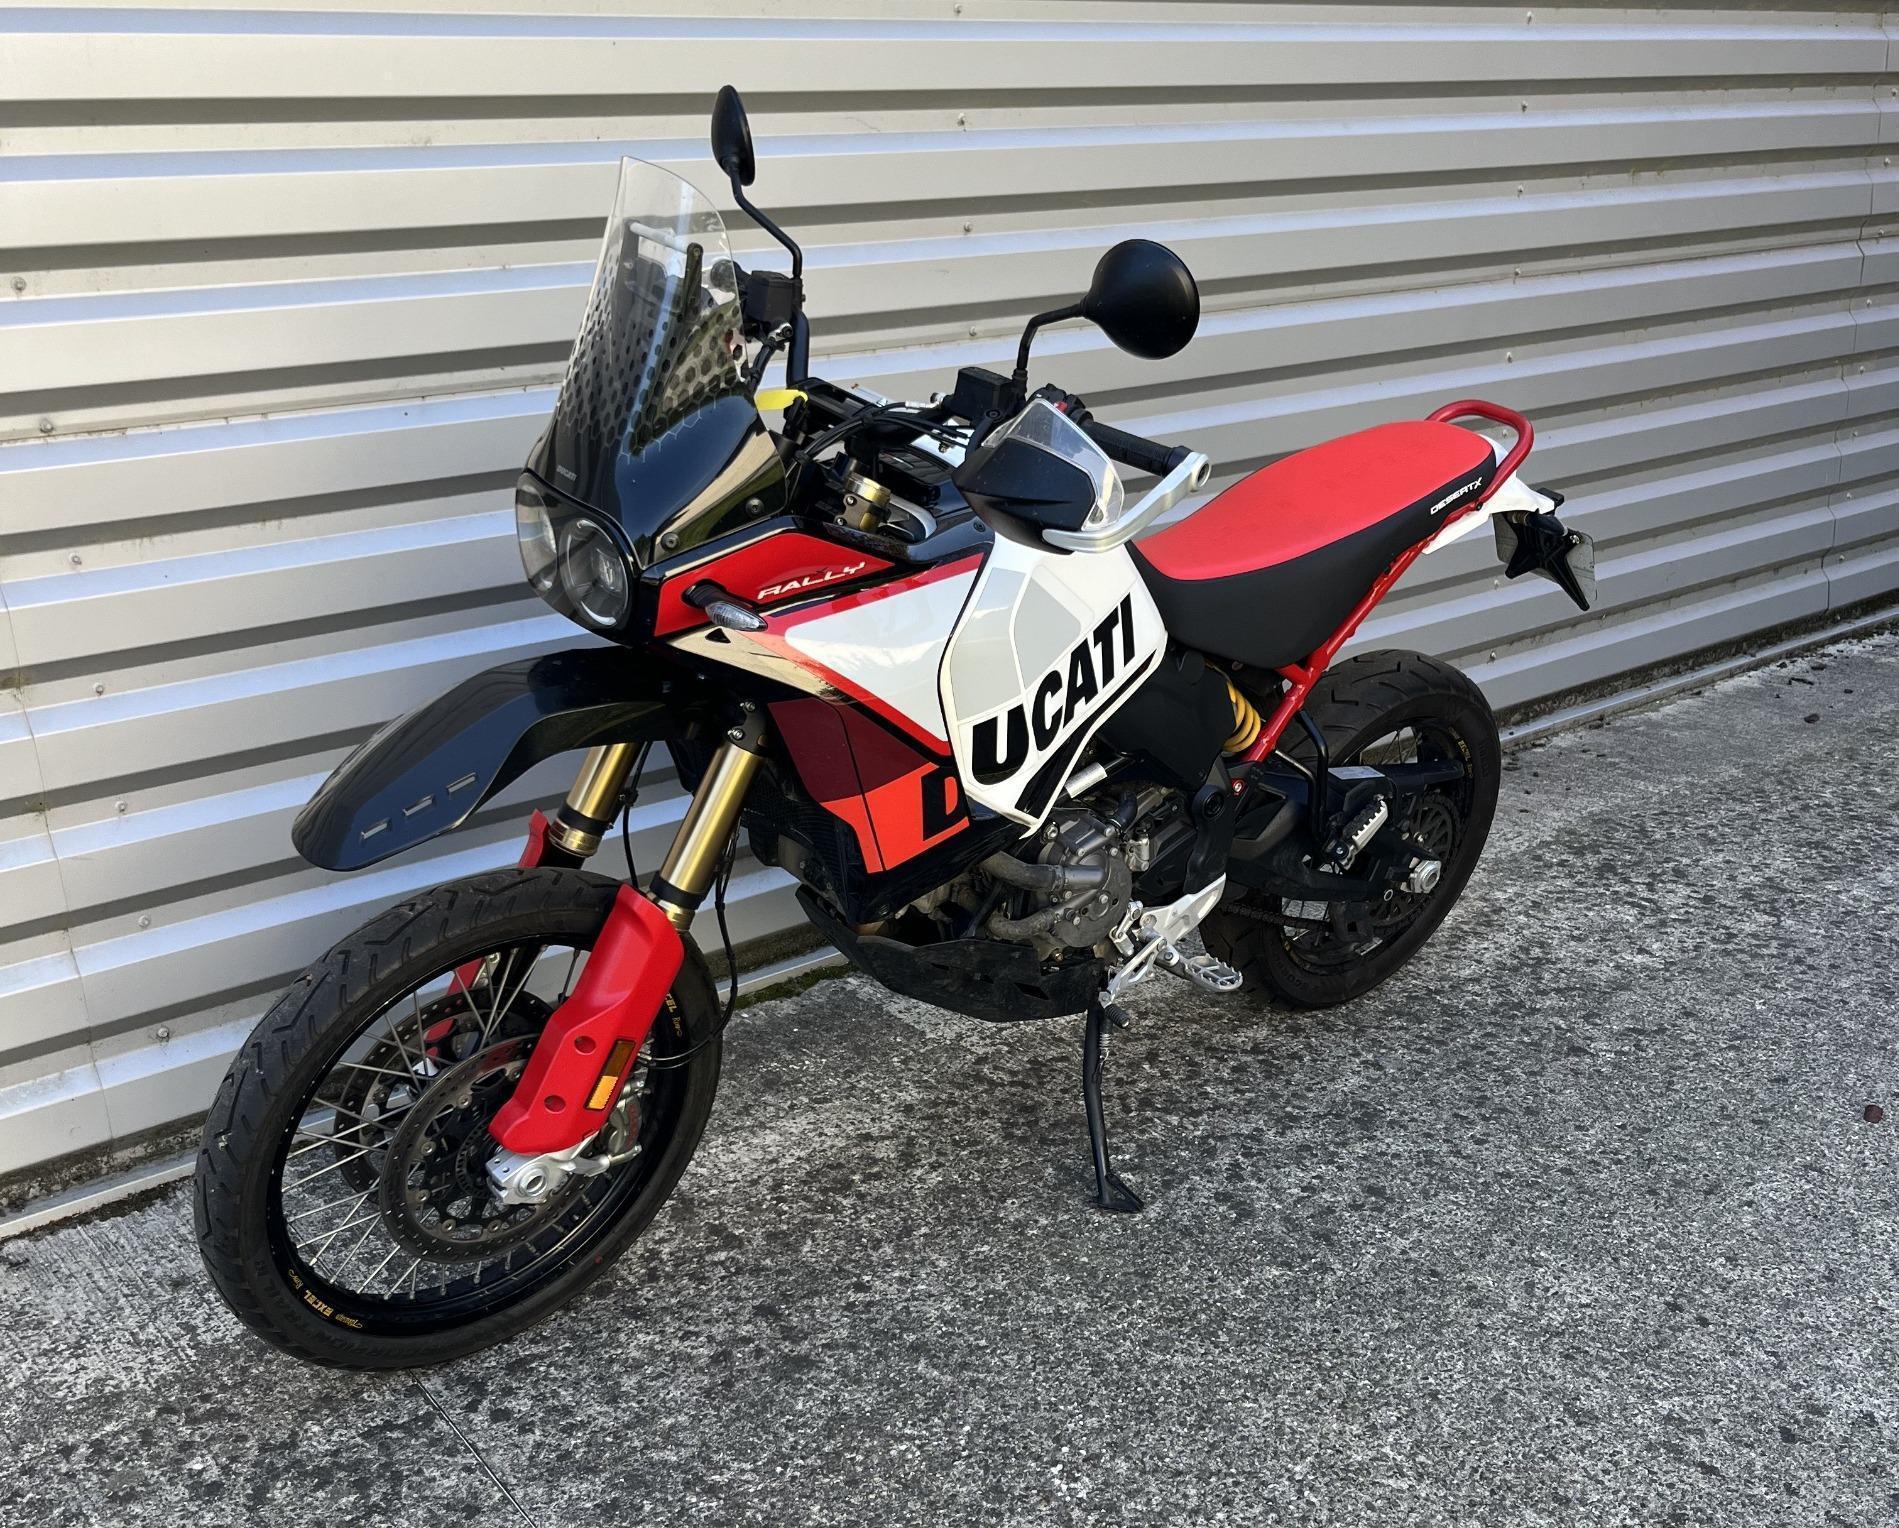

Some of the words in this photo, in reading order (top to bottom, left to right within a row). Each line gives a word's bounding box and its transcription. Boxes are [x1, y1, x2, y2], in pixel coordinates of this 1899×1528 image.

[1430, 477, 1482, 515] DESERTX
[757, 561, 866, 600] RALLY
[304, 1289, 334, 1317] EXCEL
